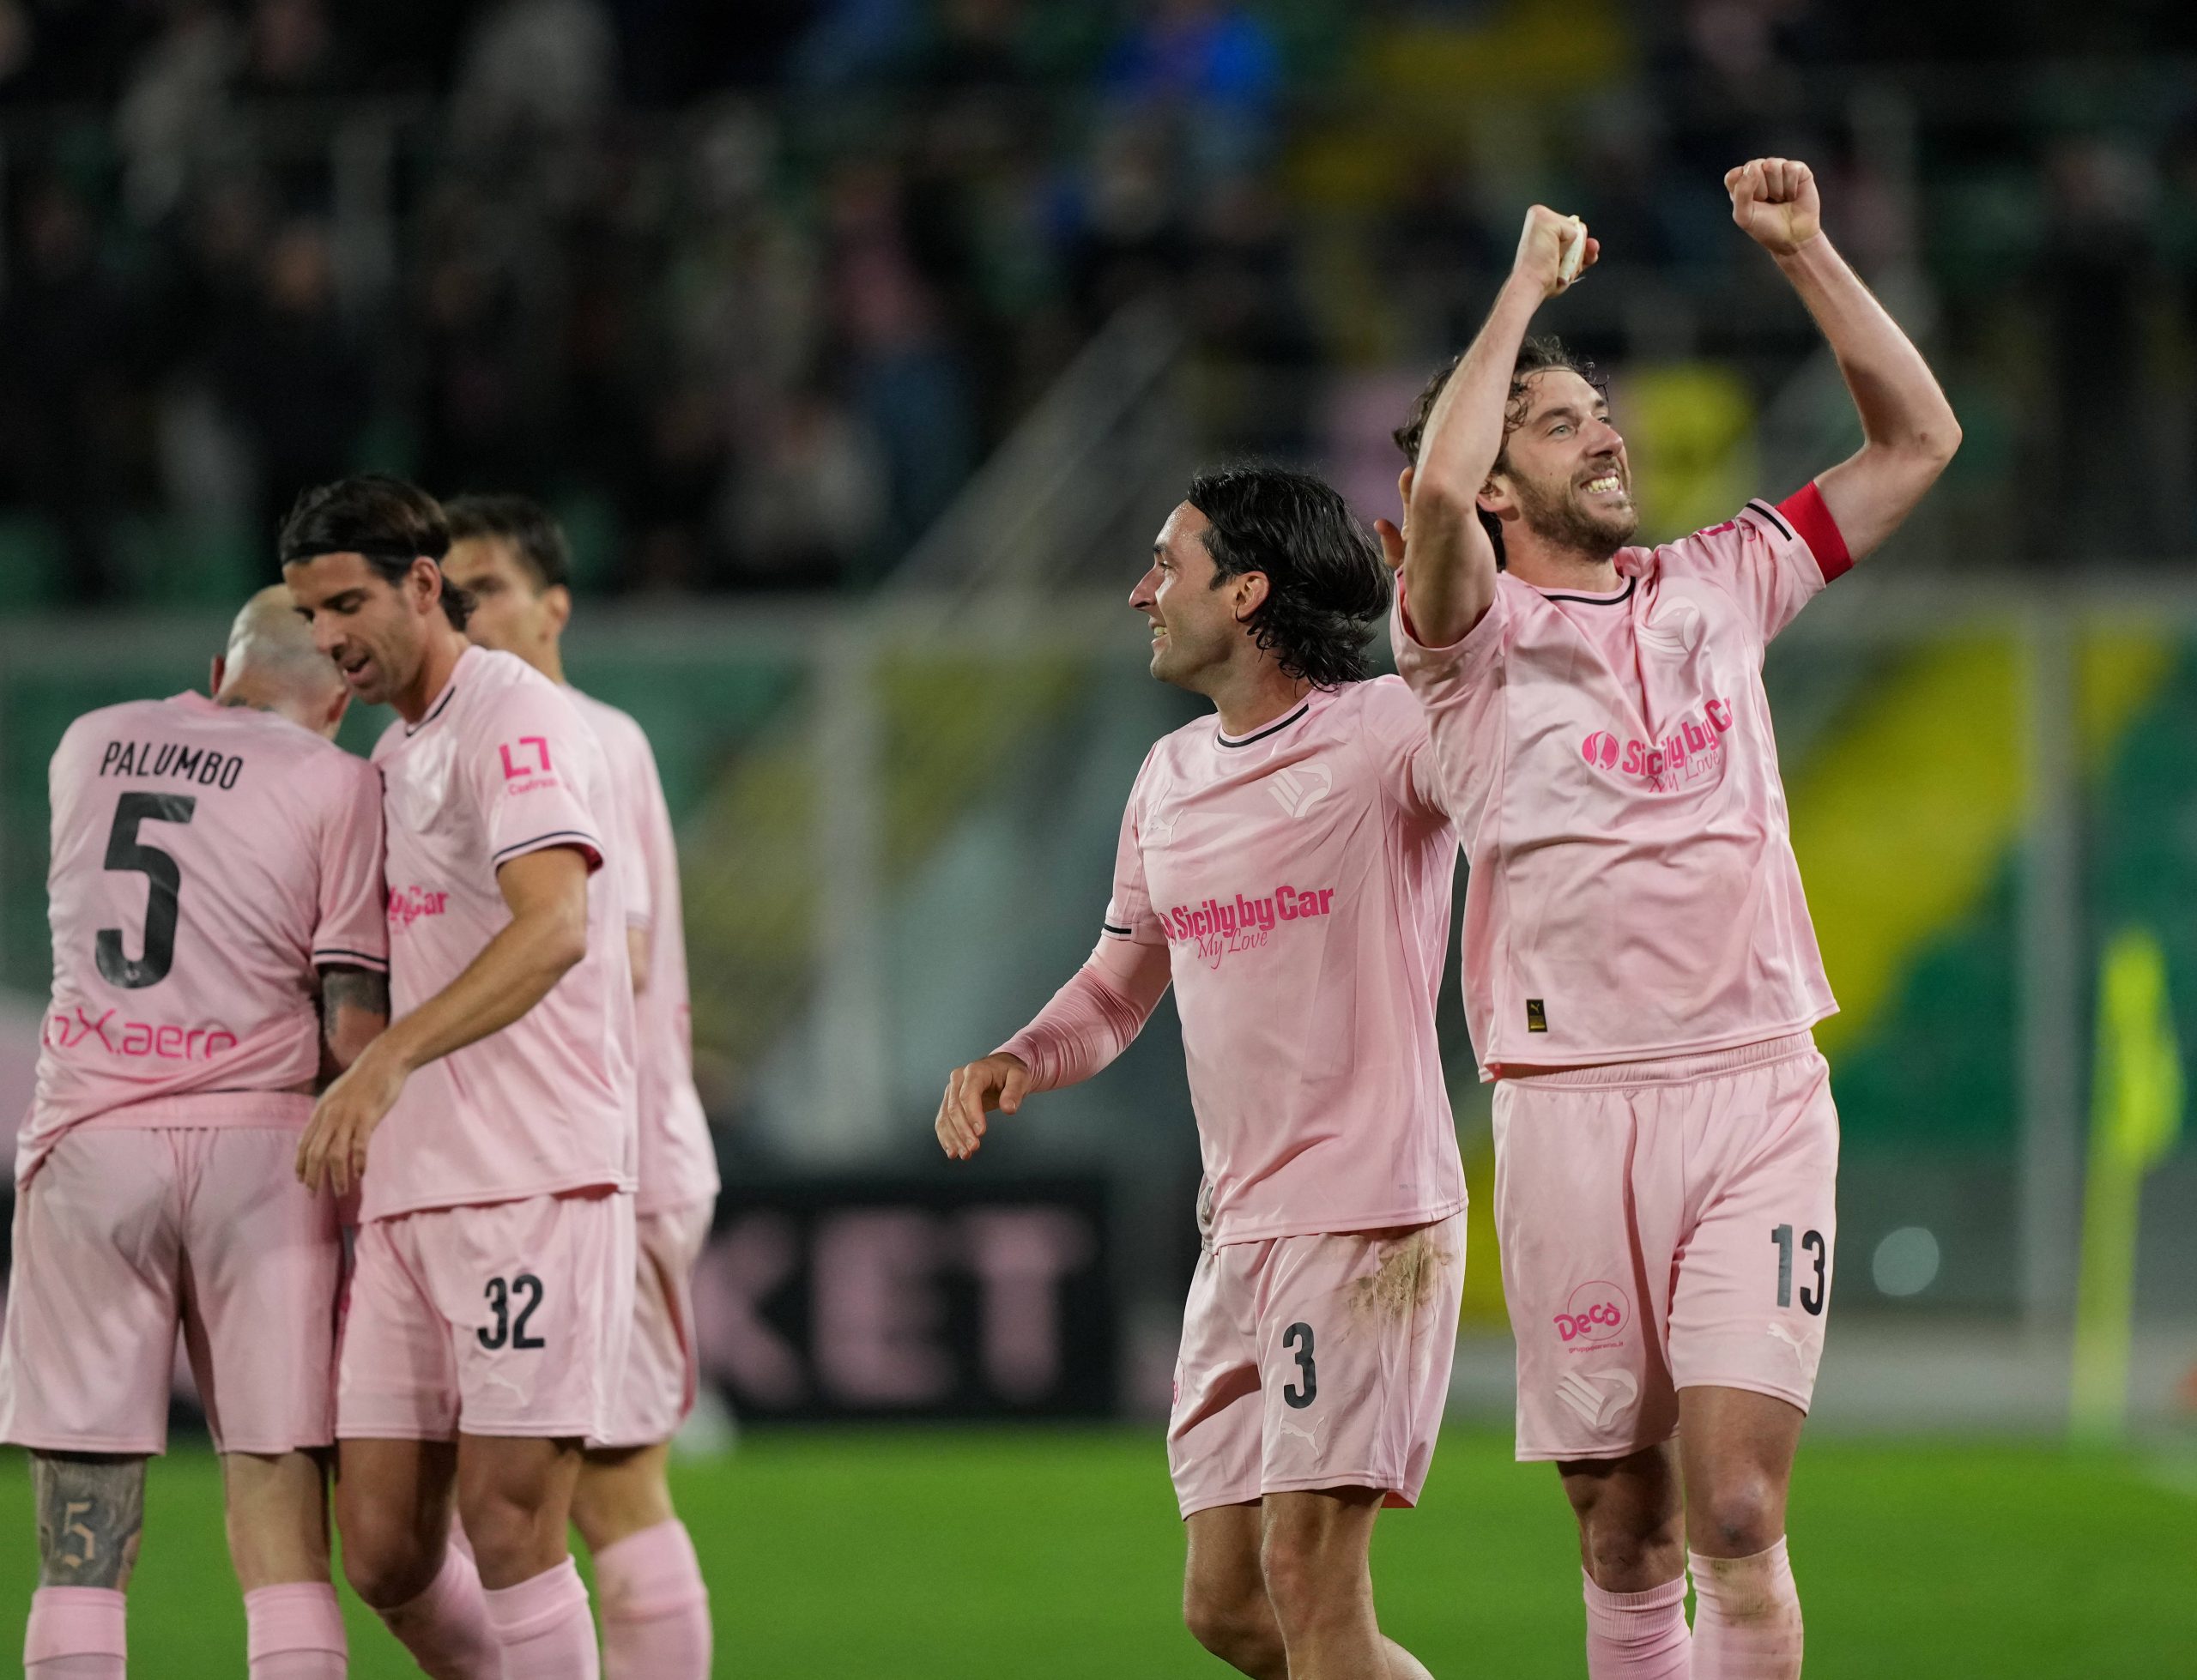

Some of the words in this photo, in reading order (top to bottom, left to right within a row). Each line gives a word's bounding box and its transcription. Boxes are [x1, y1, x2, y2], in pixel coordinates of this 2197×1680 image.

[99, 740, 244, 790] PALUMBO
[95, 791, 197, 989] 5
[1195, 932, 1223, 970] My
[1227, 928, 1268, 953] Love
[1771, 1224, 1826, 1316] 13
[477, 1274, 545, 1350] 32
[1282, 1322, 1316, 1410] 3
